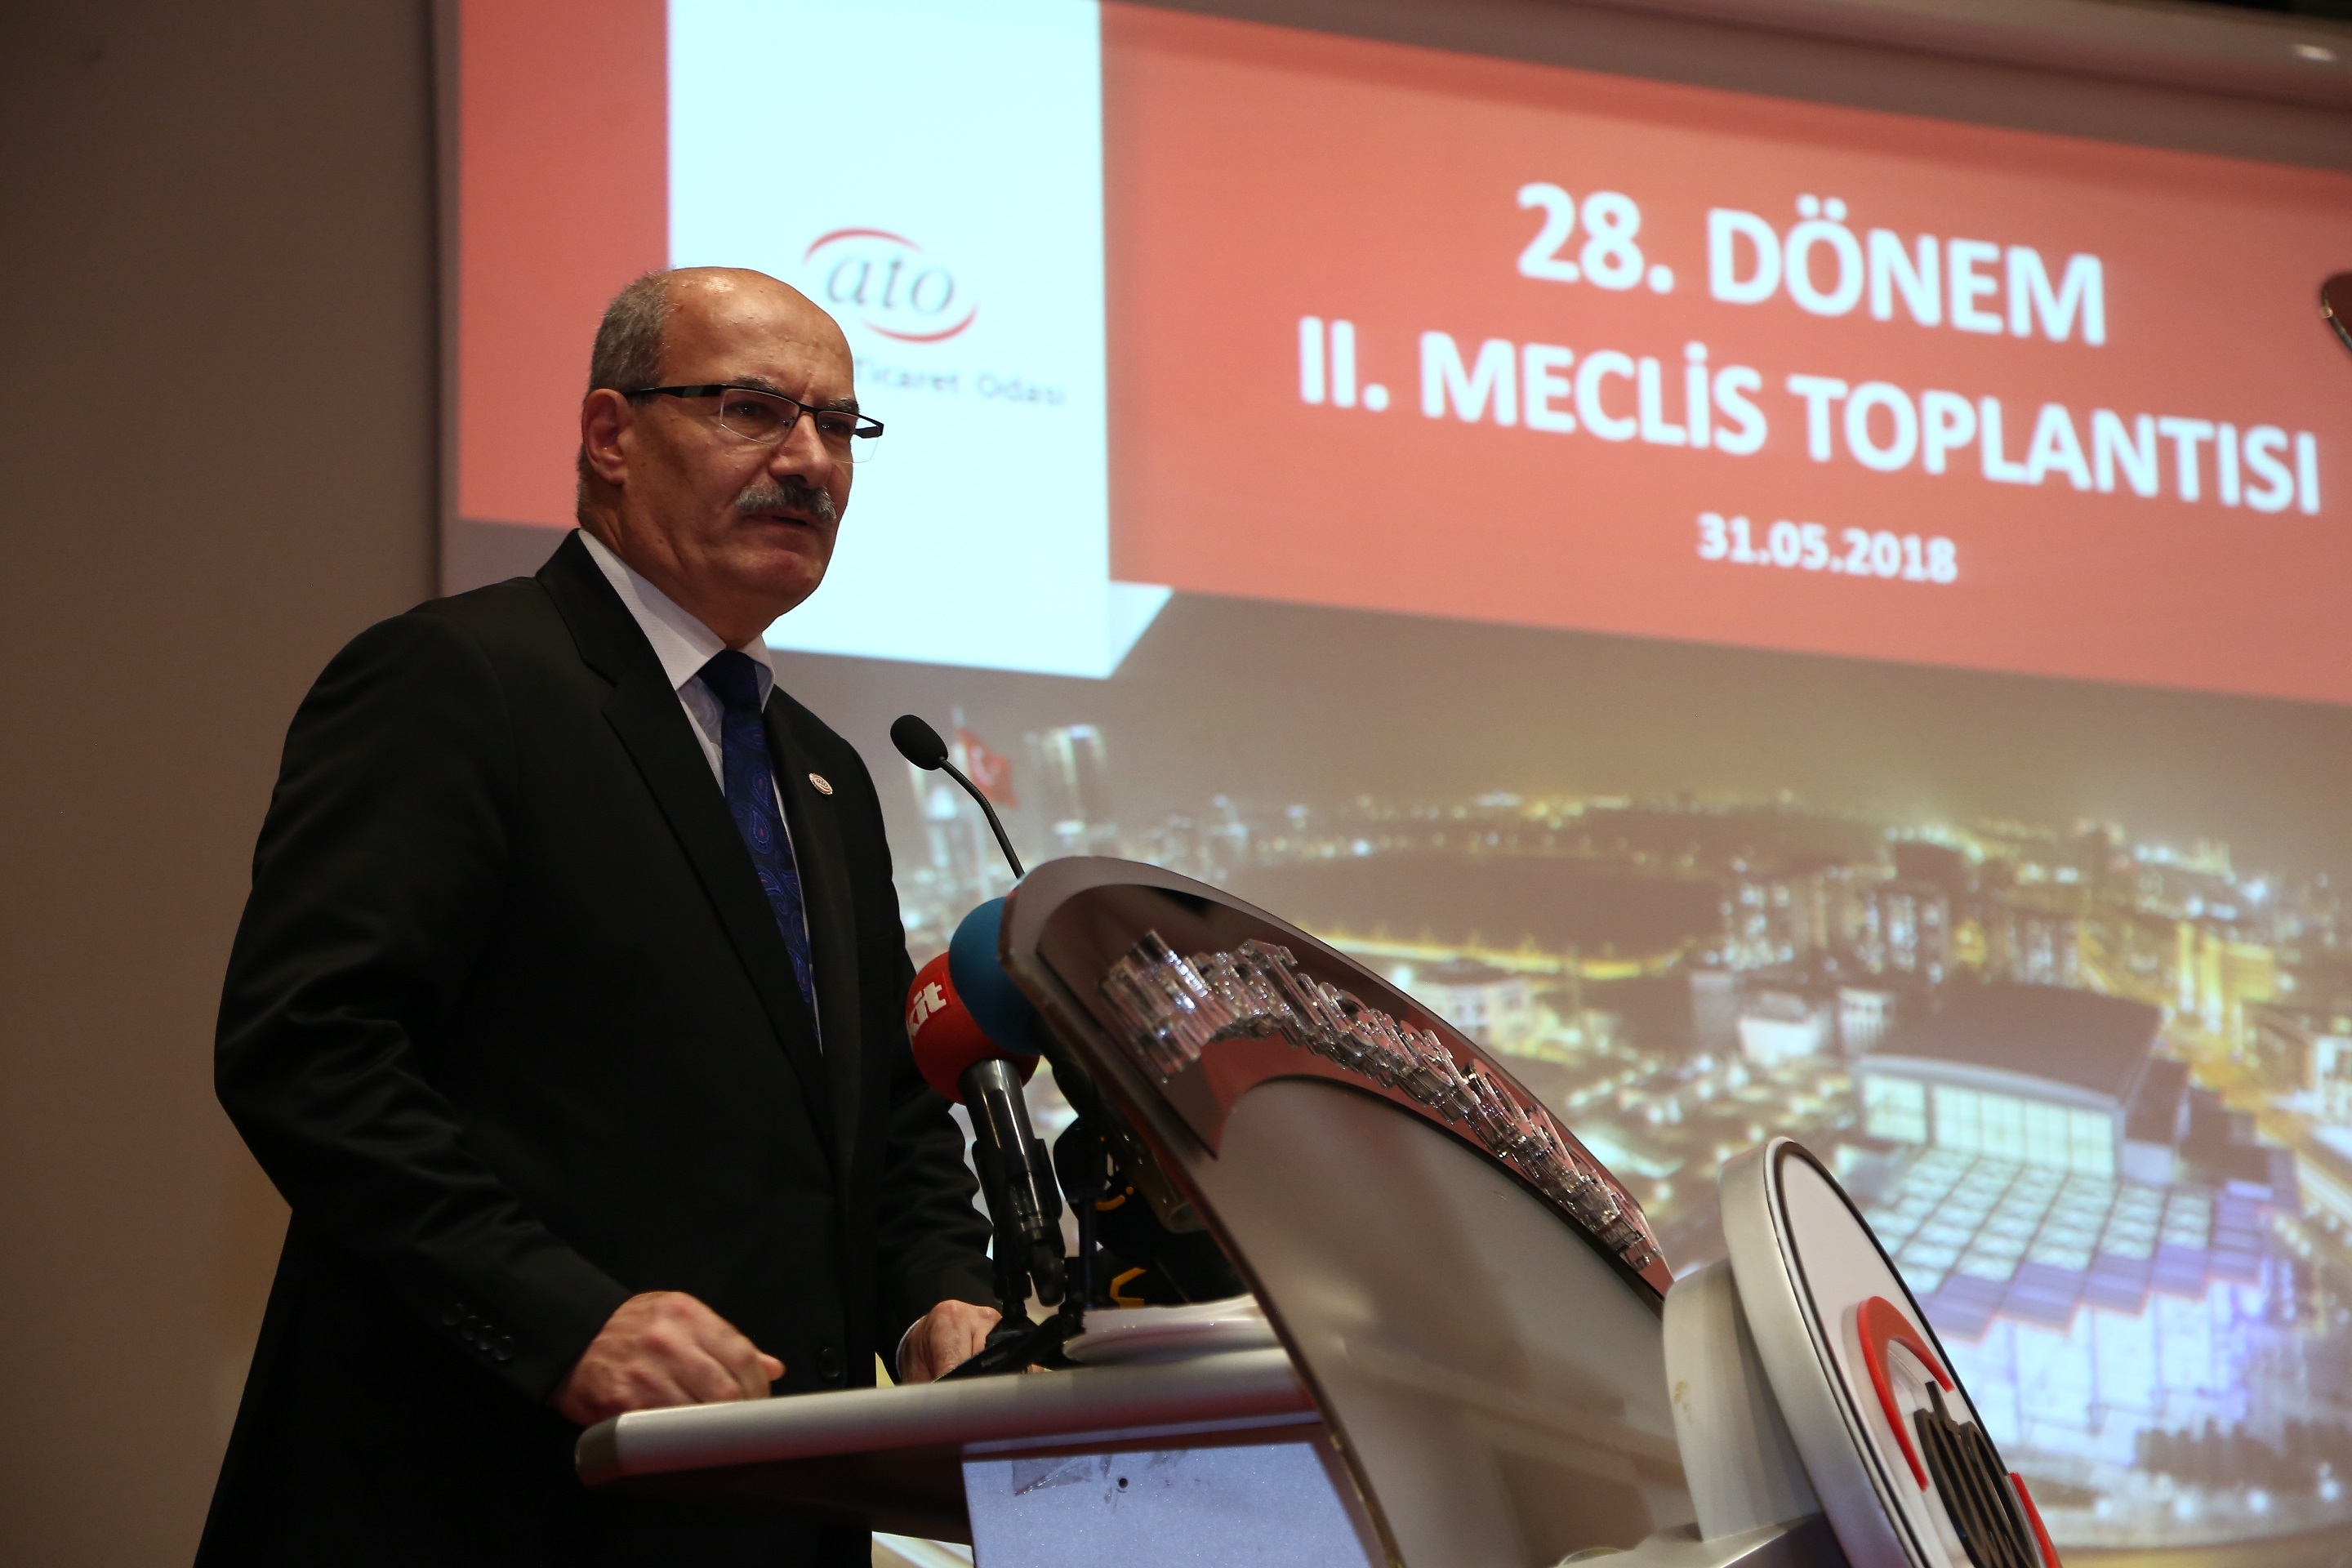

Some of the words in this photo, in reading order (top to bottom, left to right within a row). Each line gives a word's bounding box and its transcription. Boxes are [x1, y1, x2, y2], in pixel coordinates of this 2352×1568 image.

[826, 256, 955, 314] ato
[1517, 181, 1676, 295] 28.
[1707, 194, 2107, 346] DÖNEM
[1297, 315, 1390, 412] II.
[1418, 330, 1769, 457] MECLİS
[1784, 373, 2321, 515] TOPLANTISI
[1696, 511, 1958, 585] 31.05.2018
